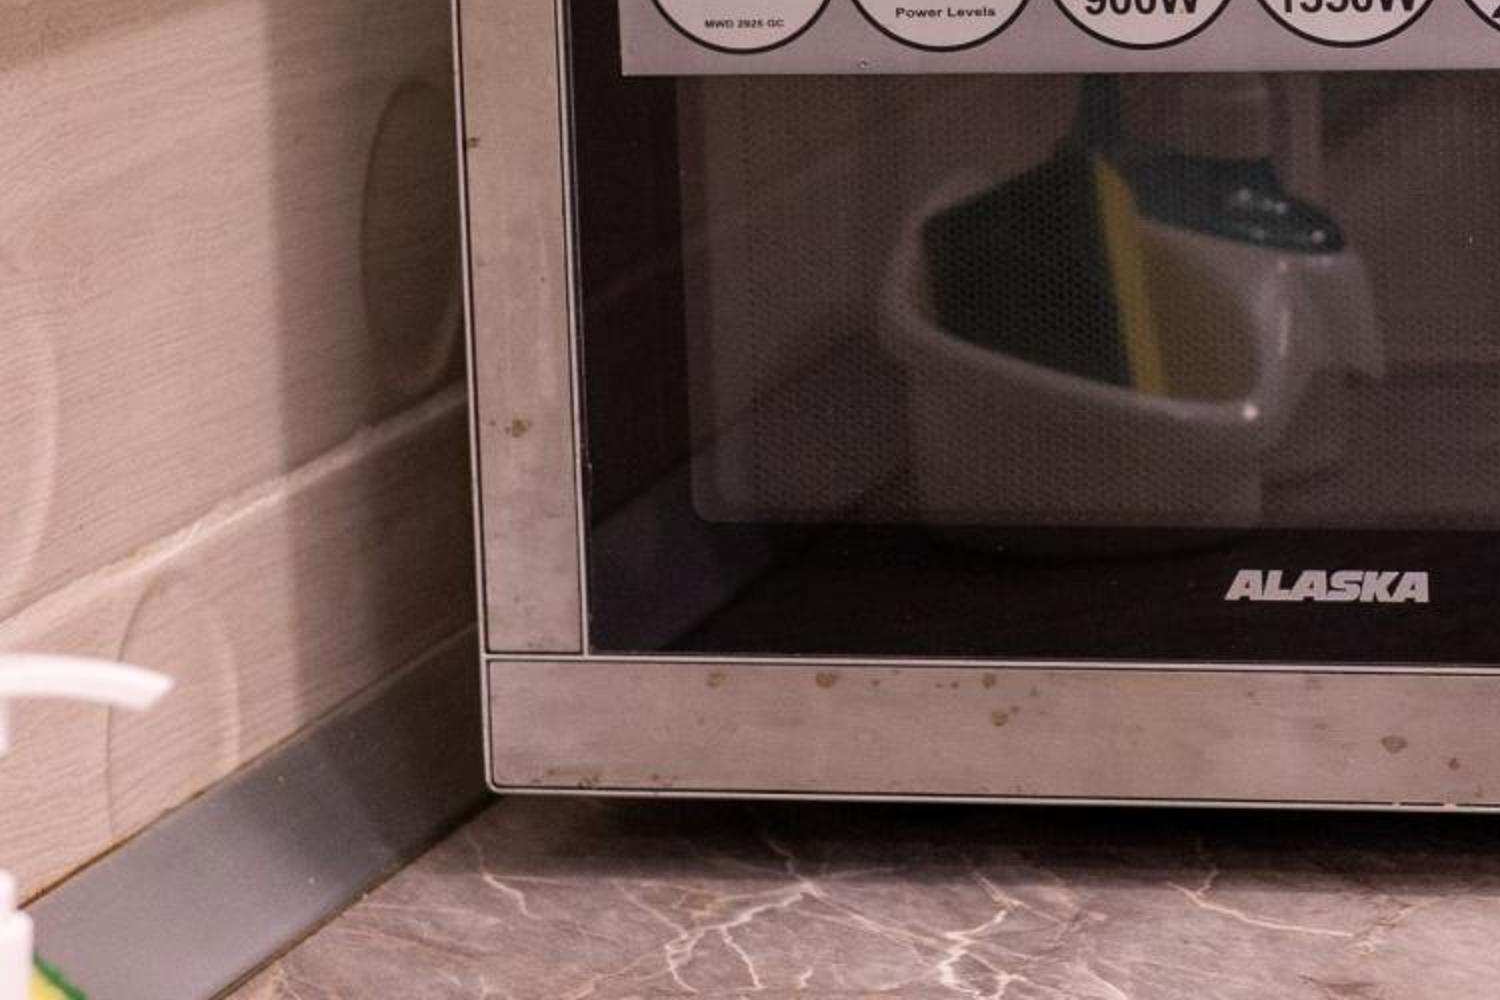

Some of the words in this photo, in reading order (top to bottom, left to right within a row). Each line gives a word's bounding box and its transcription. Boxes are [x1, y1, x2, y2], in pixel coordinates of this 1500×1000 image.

[895, 6, 942, 19] Power
[947, 6, 996, 18] Levels
[1224, 569, 1429, 603] ALASKA
